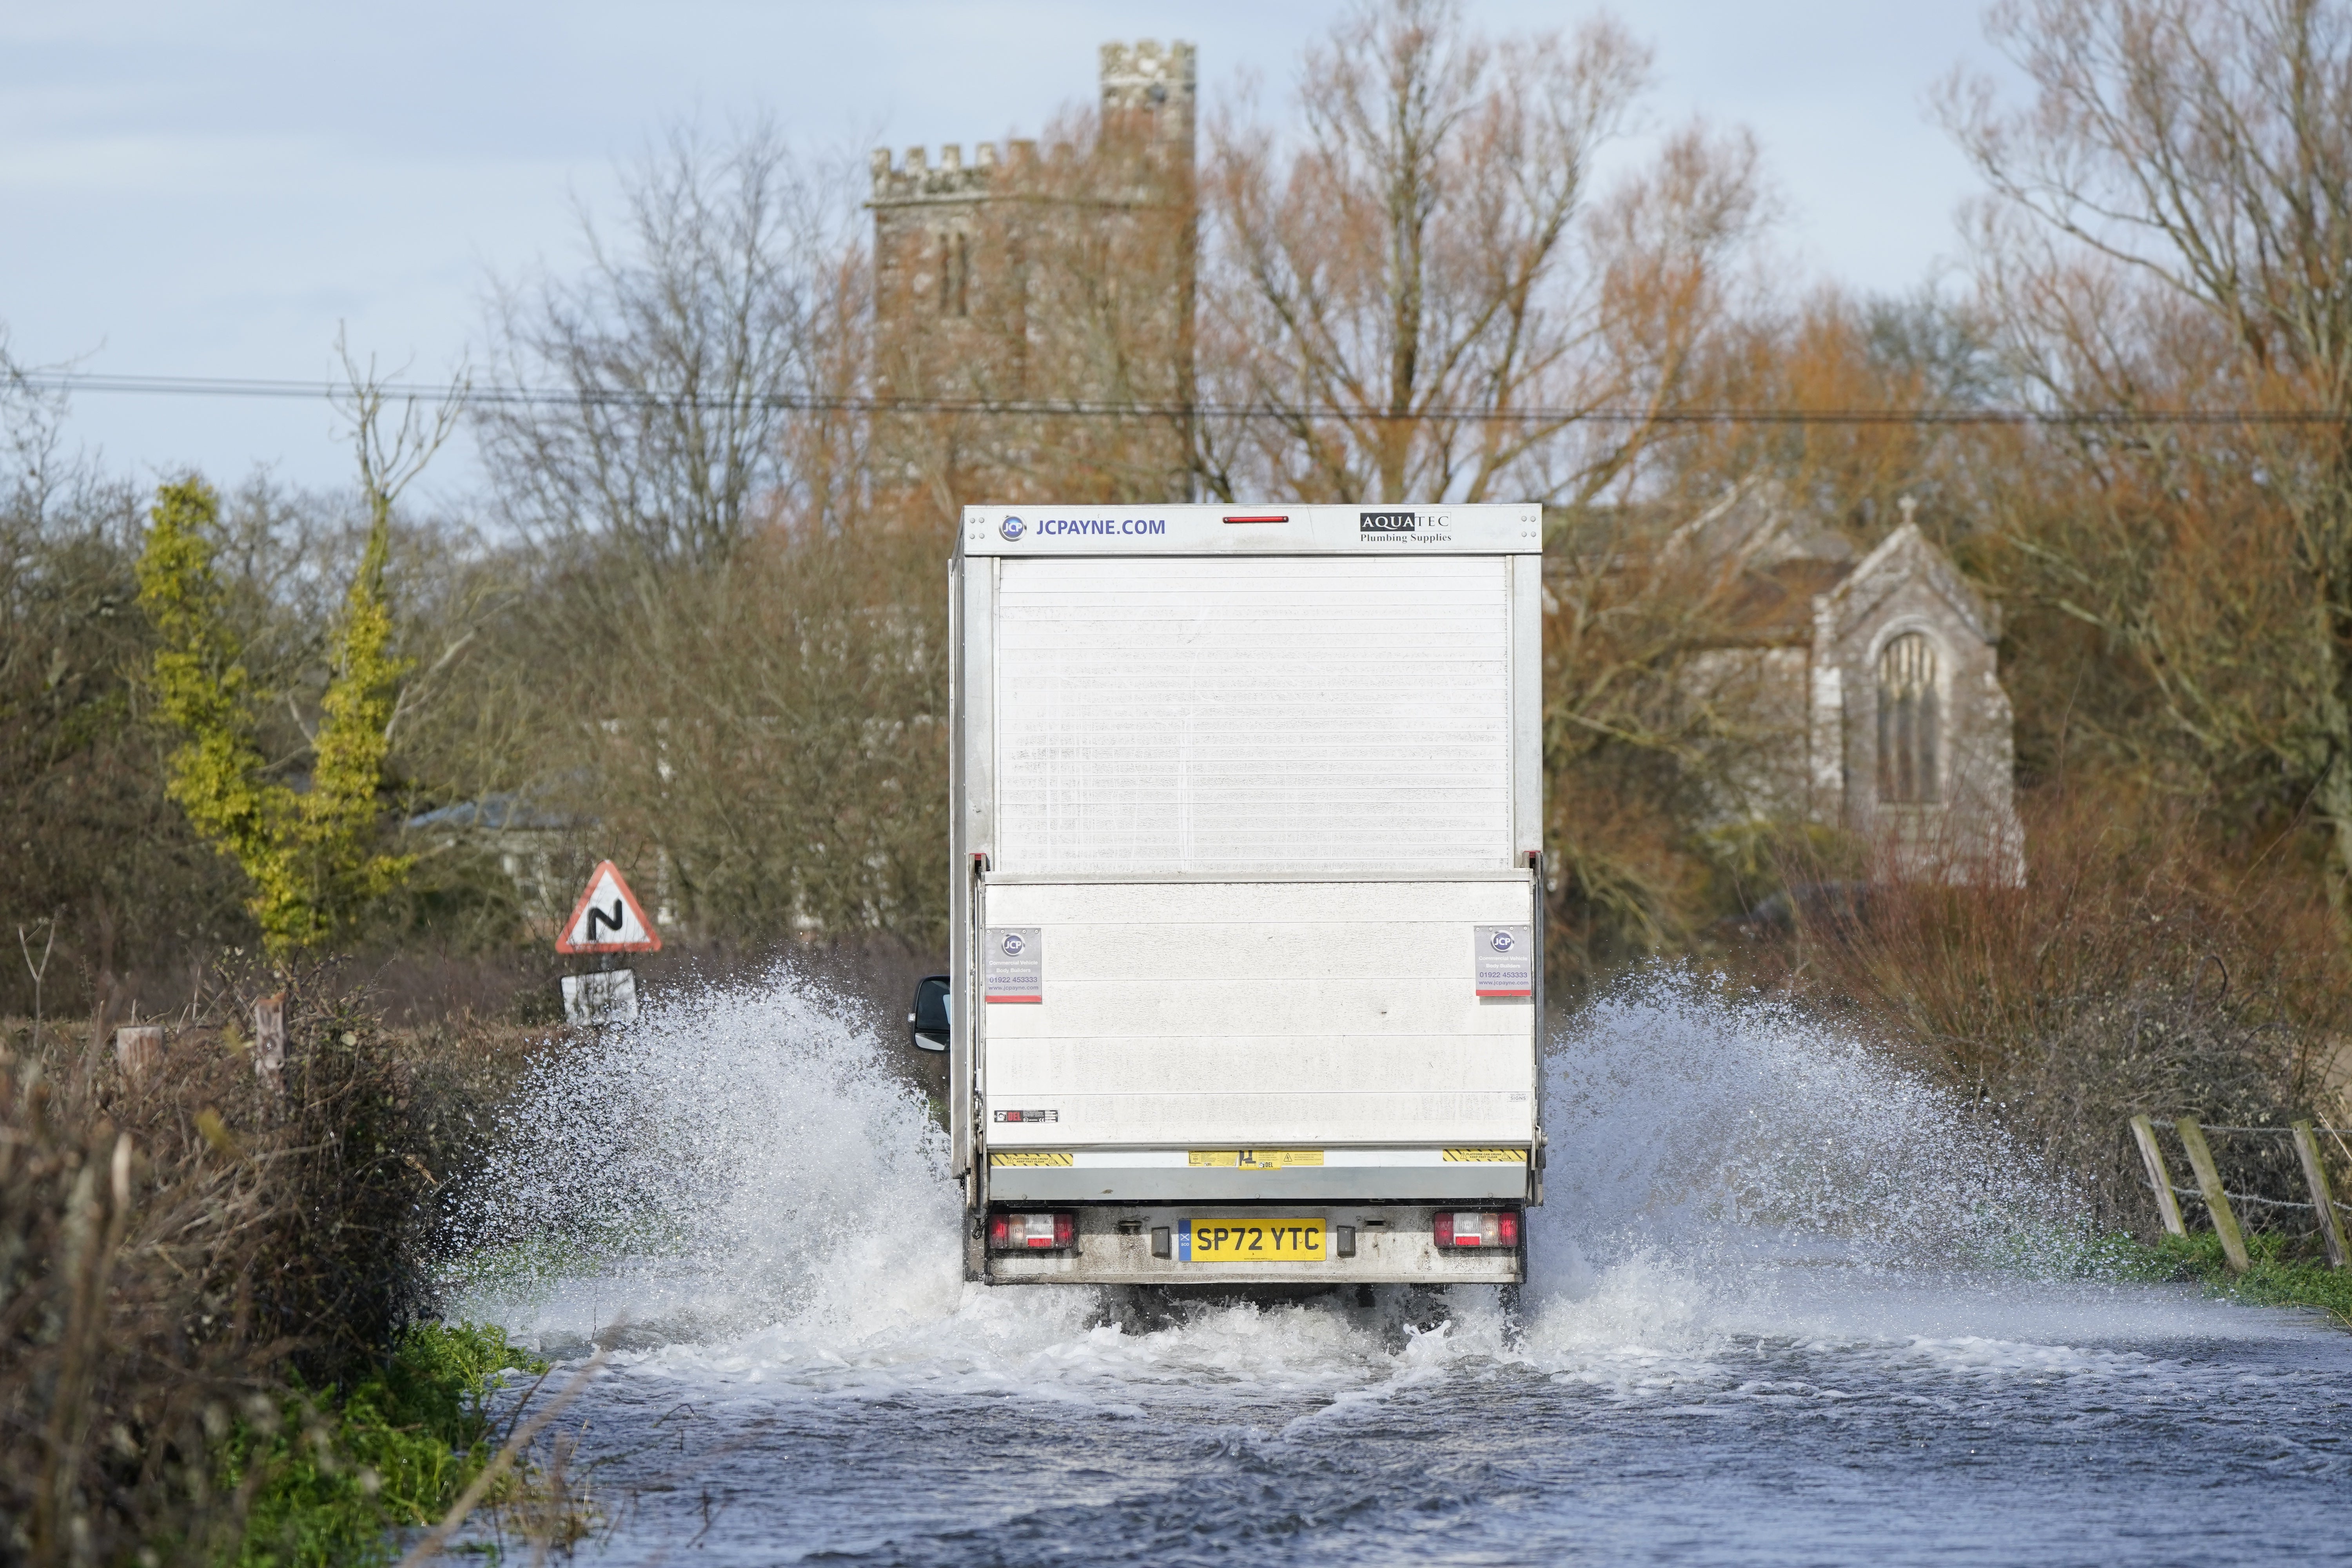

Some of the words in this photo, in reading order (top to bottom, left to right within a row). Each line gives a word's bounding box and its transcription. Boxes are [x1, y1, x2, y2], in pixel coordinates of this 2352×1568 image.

[1004, 522, 1023, 532] JCP
[1036, 520, 1165, 535] JCPAYNE.COM
[1360, 534, 1407, 543] Plumbing
[1411, 534, 1451, 544] Supplies
[1005, 941, 1022, 949] JCP
[1008, 1111, 1022, 1121] DEL
[1198, 1227, 1262, 1251] SP72
[1271, 1227, 1319, 1250] YTC
